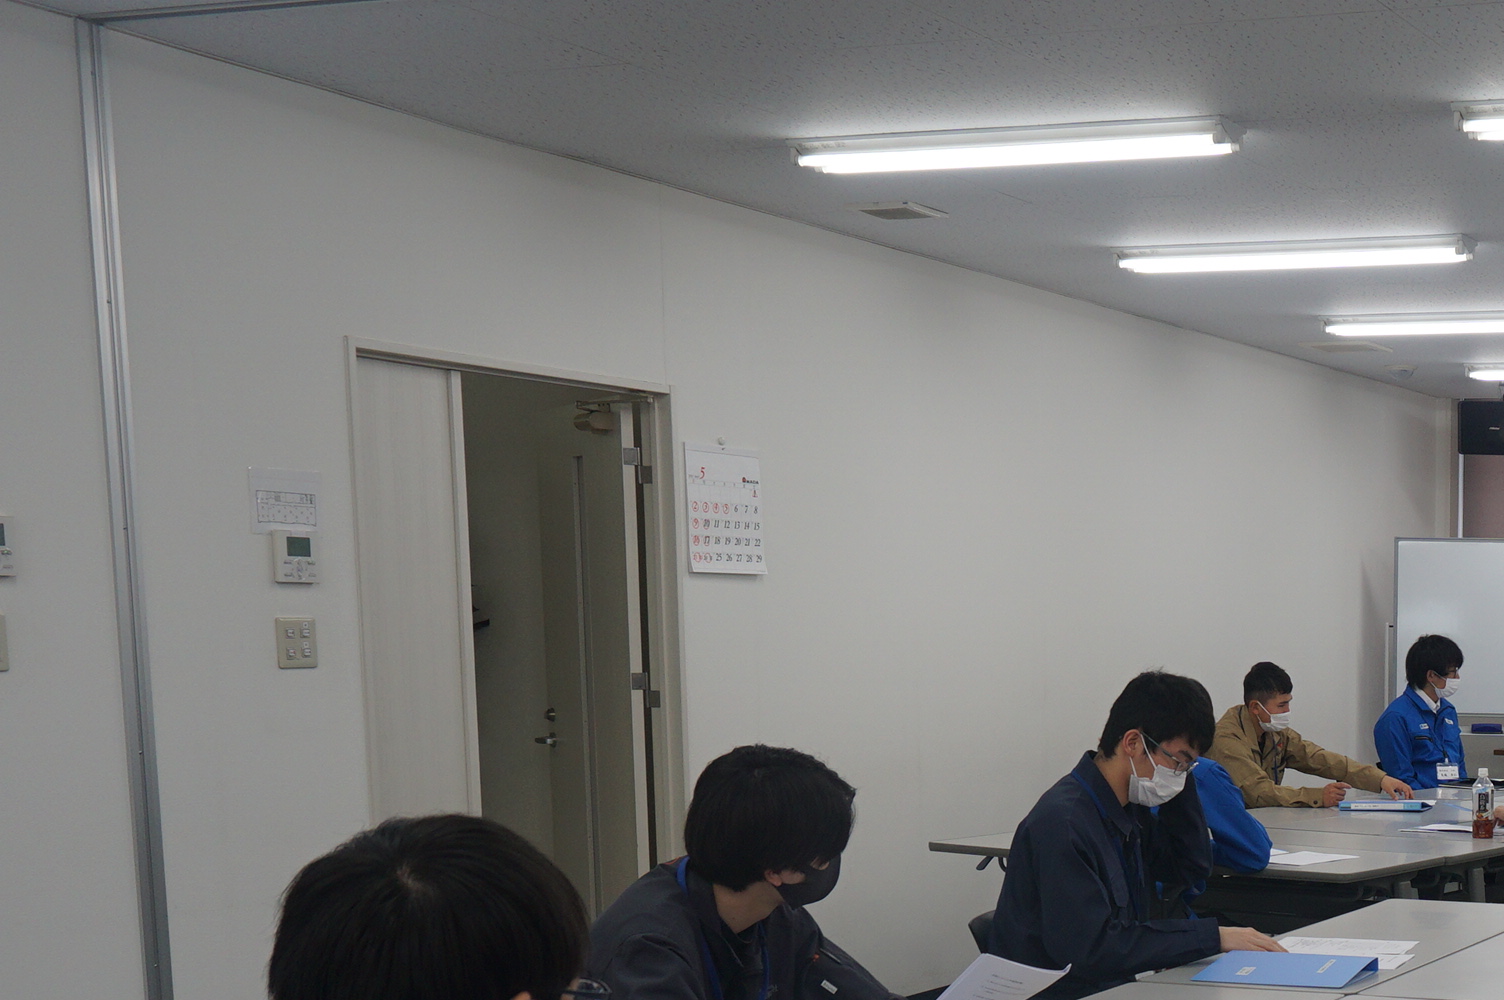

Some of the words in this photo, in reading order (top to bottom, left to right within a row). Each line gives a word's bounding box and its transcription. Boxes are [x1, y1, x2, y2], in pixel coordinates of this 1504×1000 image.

[699, 466, 706, 480] 5
[733, 504, 739, 513] 6
[744, 505, 749, 514] 7
[753, 505, 759, 515] 8
[714, 519, 720, 528] 11
[724, 520, 731, 529] 12
[734, 520, 741, 530] 13
[744, 521, 750, 530] 14
[753, 522, 760, 531] 15
[714, 536, 721, 545] 18
[724, 537, 732, 546] 19
[734, 537, 742, 546] 20
[744, 538, 751, 547] 21
[754, 538, 761, 547] 22
[715, 552, 723, 562] 25
[725, 553, 733, 562] 26
[736, 553, 743, 563] 27
[746, 554, 753, 563] 28
[755, 554, 763, 564] 29
